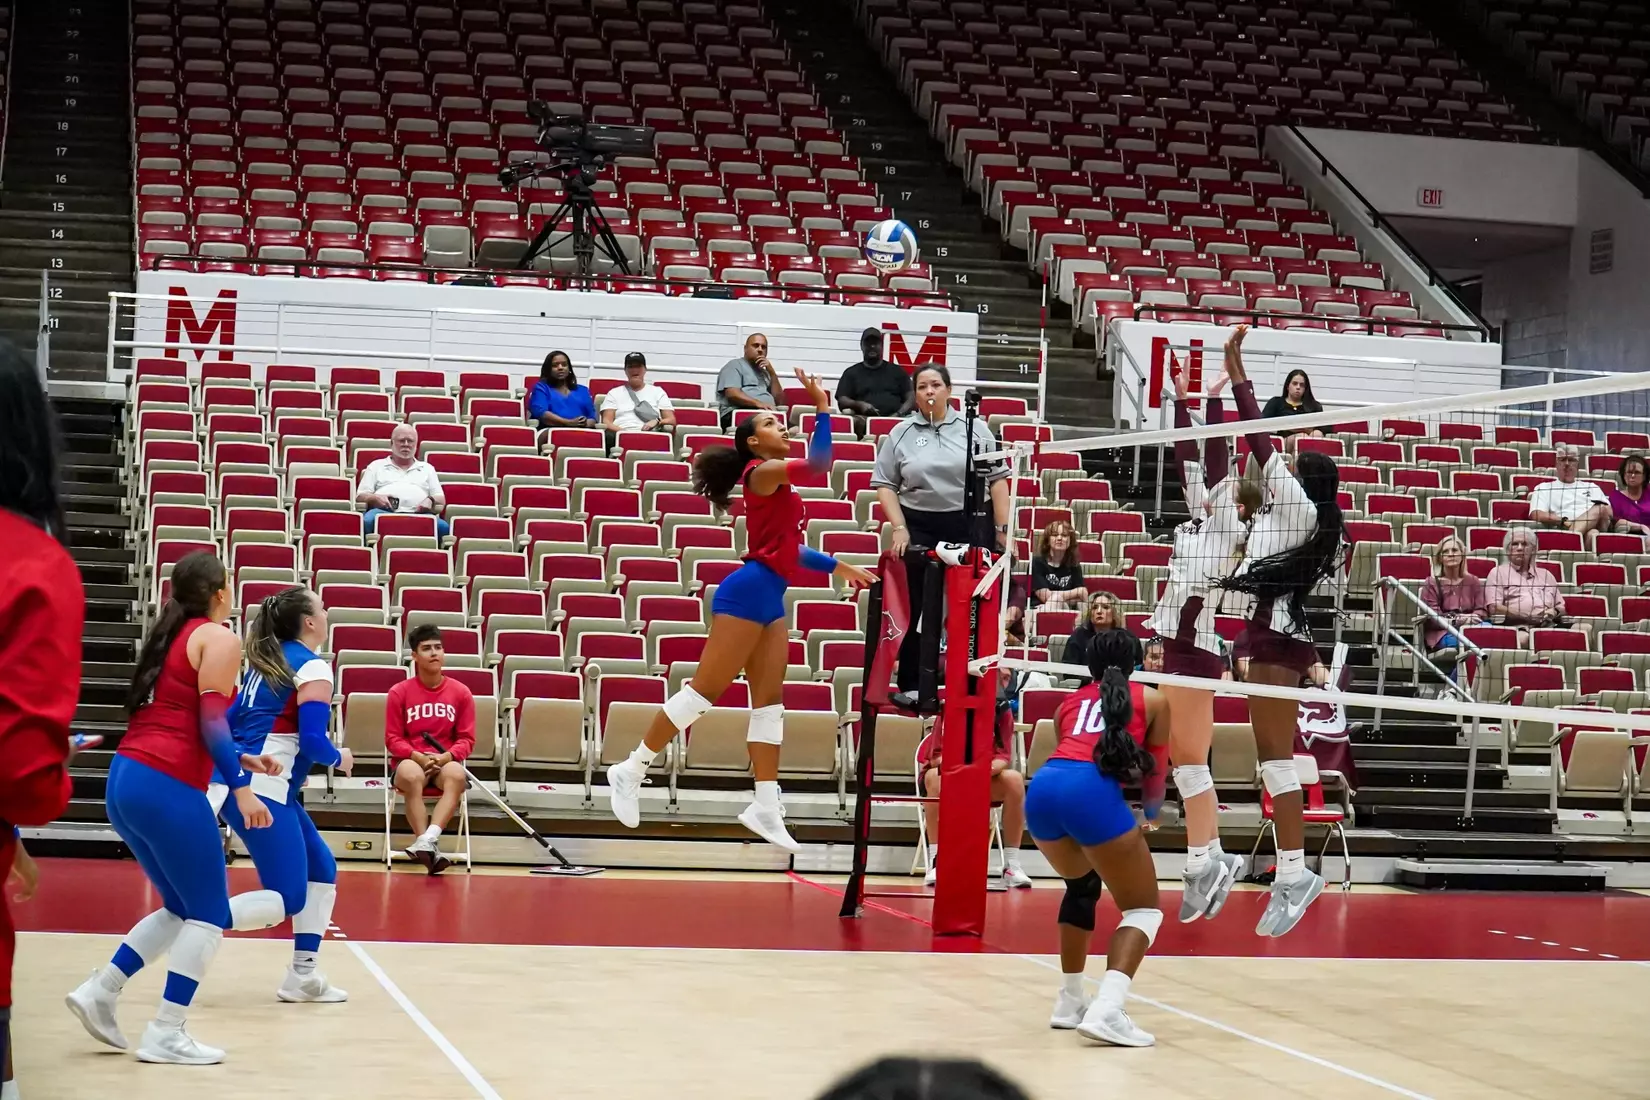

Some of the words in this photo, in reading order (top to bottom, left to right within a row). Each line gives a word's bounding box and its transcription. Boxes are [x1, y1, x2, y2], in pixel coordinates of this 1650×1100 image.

[65, 98, 77, 107] 19
[57, 121, 69, 131] 18
[56, 147, 67, 156] 17
[871, 142, 882, 151] 19
[884, 166, 896, 175] 18
[55, 174, 67, 184] 16
[901, 191, 912, 201] 17
[1423, 189, 1443, 205] EXIT
[52, 202, 65, 212] 15
[918, 220, 930, 229] 16
[51, 228, 64, 239] 14
[936, 247, 948, 257] 15
[51, 258, 64, 268] 13
[955, 274, 968, 284] 14
[49, 287, 63, 298] 12
[977, 303, 989, 314] 13
[49, 317, 59, 329] 11
[164, 286, 238, 362] M
[996, 333, 1009, 344] 12
[882, 322, 948, 378] M
[1018, 363, 1029, 374] 11
[406, 702, 456, 724] HOGS
